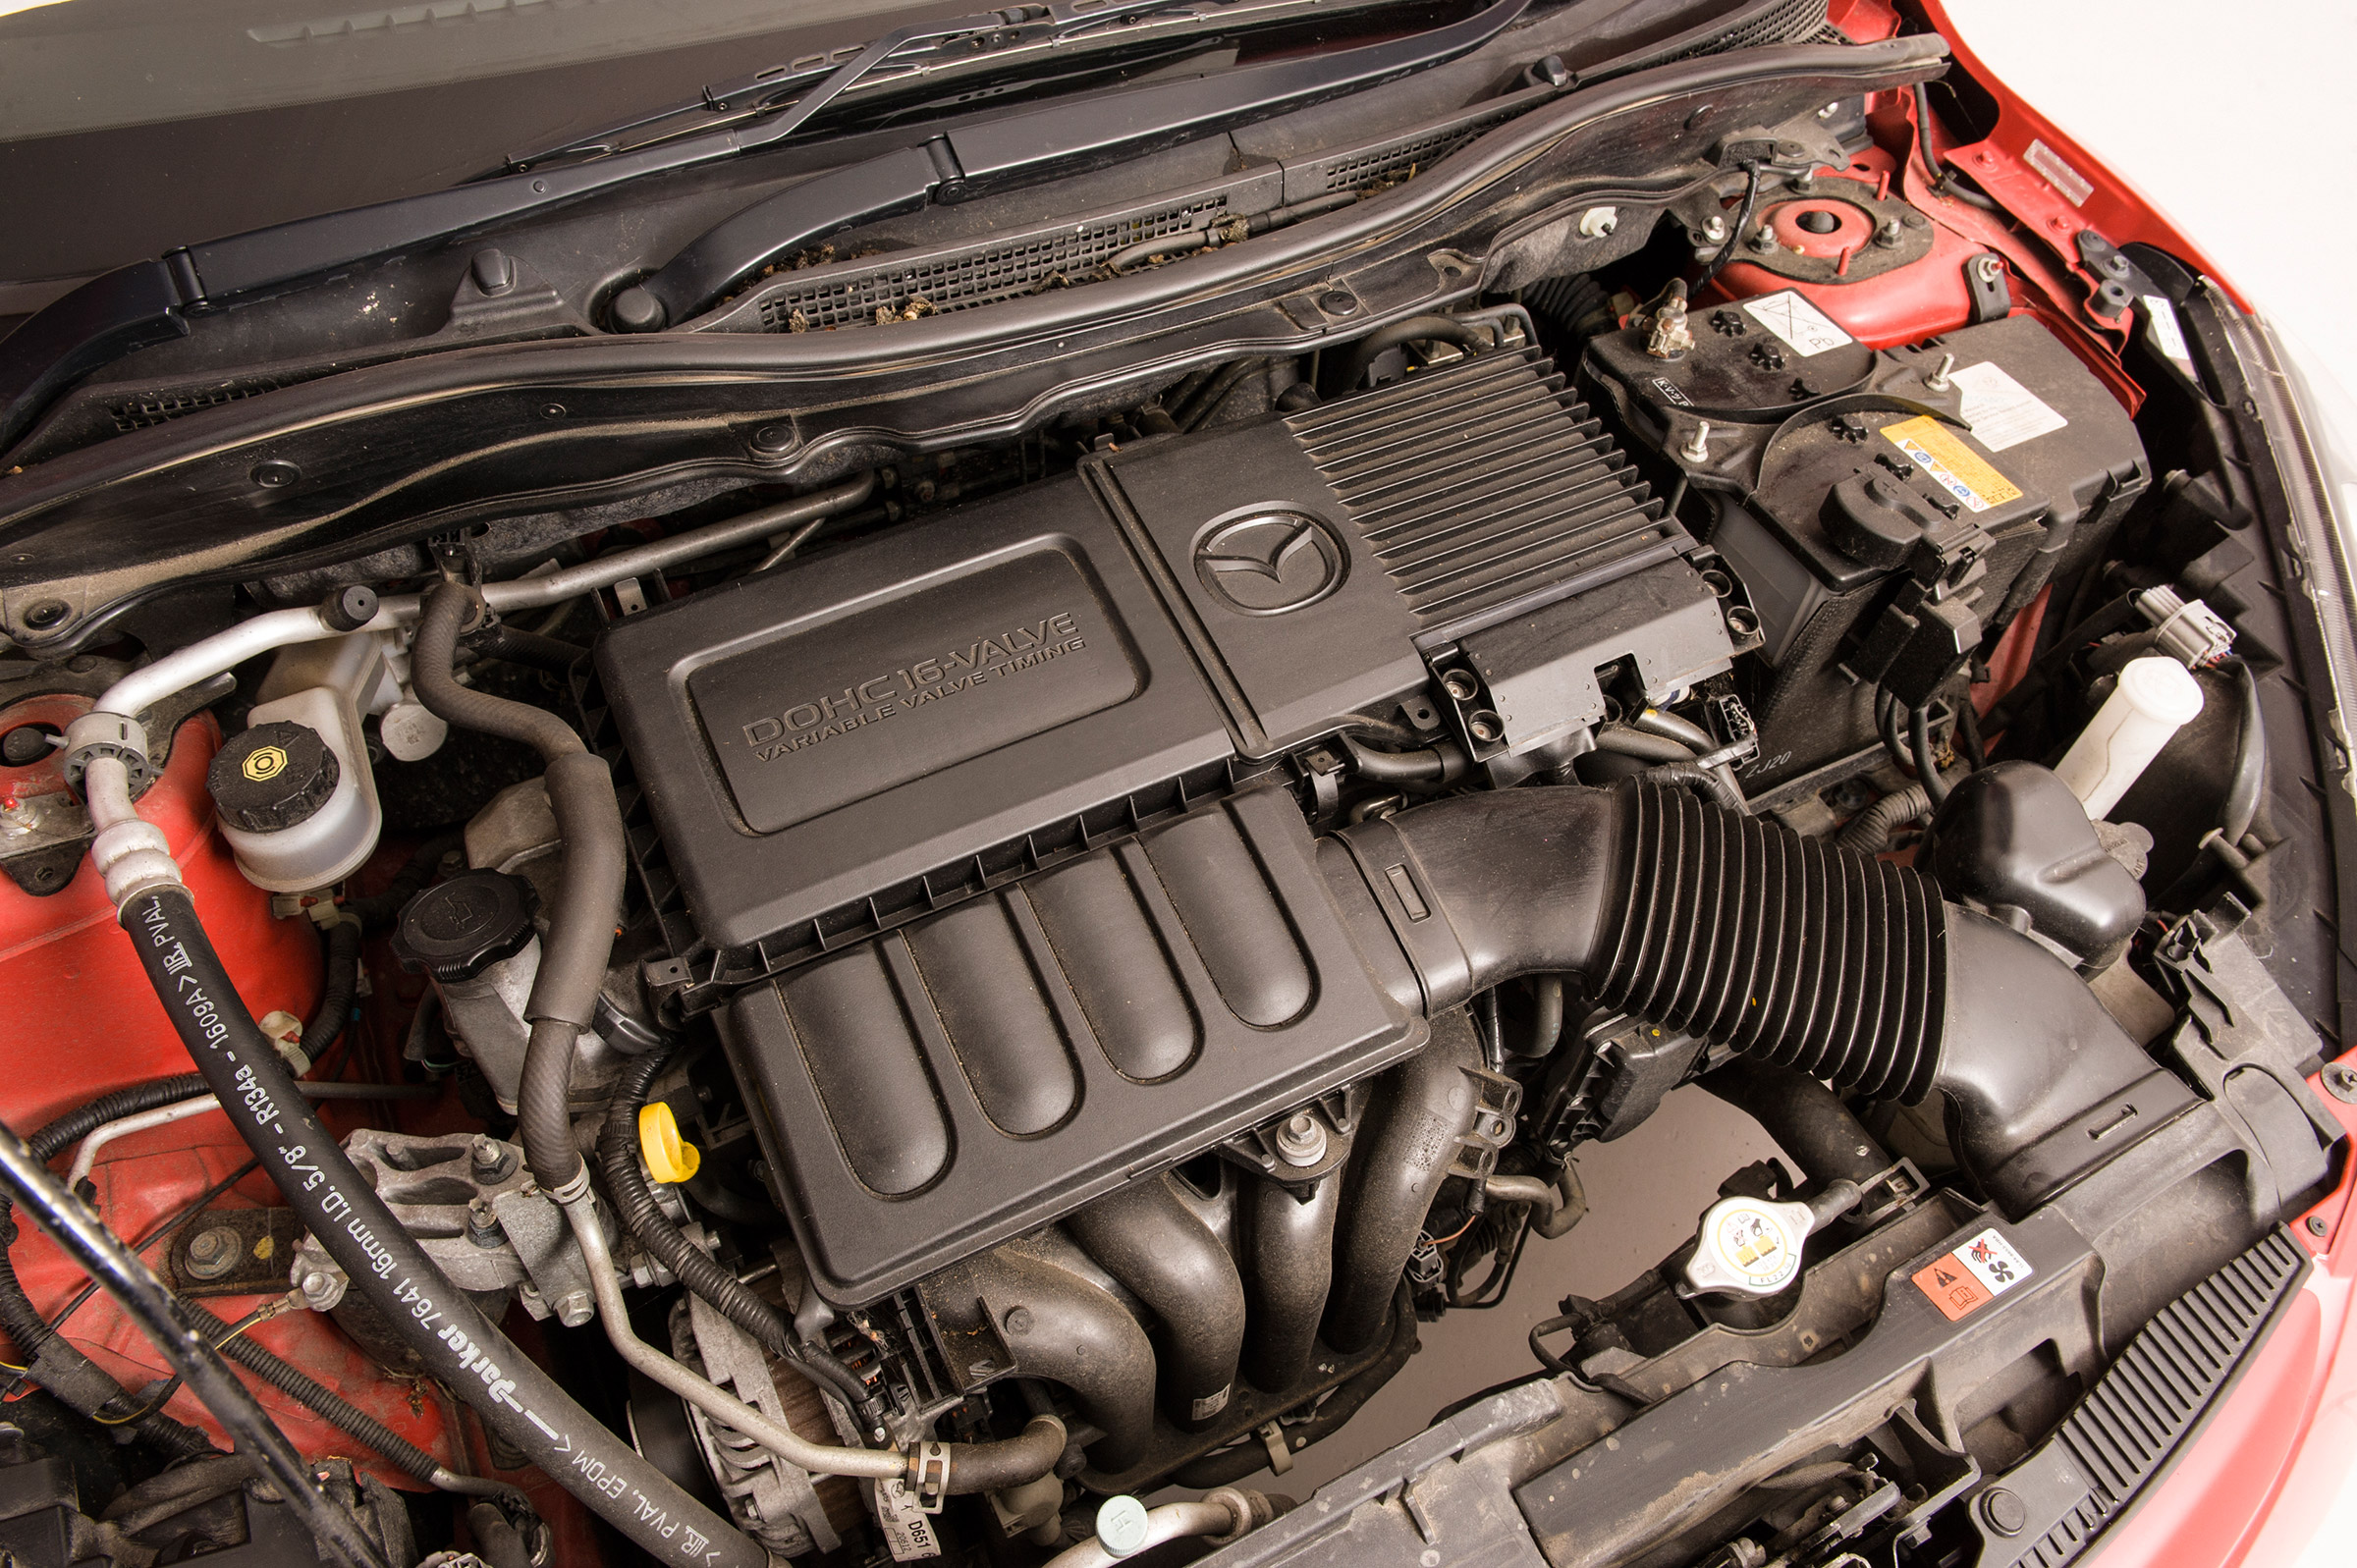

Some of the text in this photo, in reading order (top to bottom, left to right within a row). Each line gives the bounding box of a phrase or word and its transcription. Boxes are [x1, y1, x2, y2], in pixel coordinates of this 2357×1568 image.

[1808, 337, 1836, 350] Pb
[741, 612, 1079, 748] DOHC 16-VALVE
[754, 636, 1086, 763] VARIABLE VALVE TIMING
[1745, 751, 1791, 779] ZJ20
[141, 895, 175, 947] PVAL,
[186, 987, 229, 1050] 1609A
[234, 1063, 280, 1126] R134a
[320, 1185, 353, 1223] I.D.
[347, 1217, 398, 1280] 16mm
[392, 1277, 443, 1330] 7641
[437, 1324, 521, 1409] Parker
[572, 1449, 628, 1499] EPDM
[896, 1532, 912, 1552] 20612
[907, 1520, 932, 1548] D651
[1110, 1509, 1133, 1534] H
